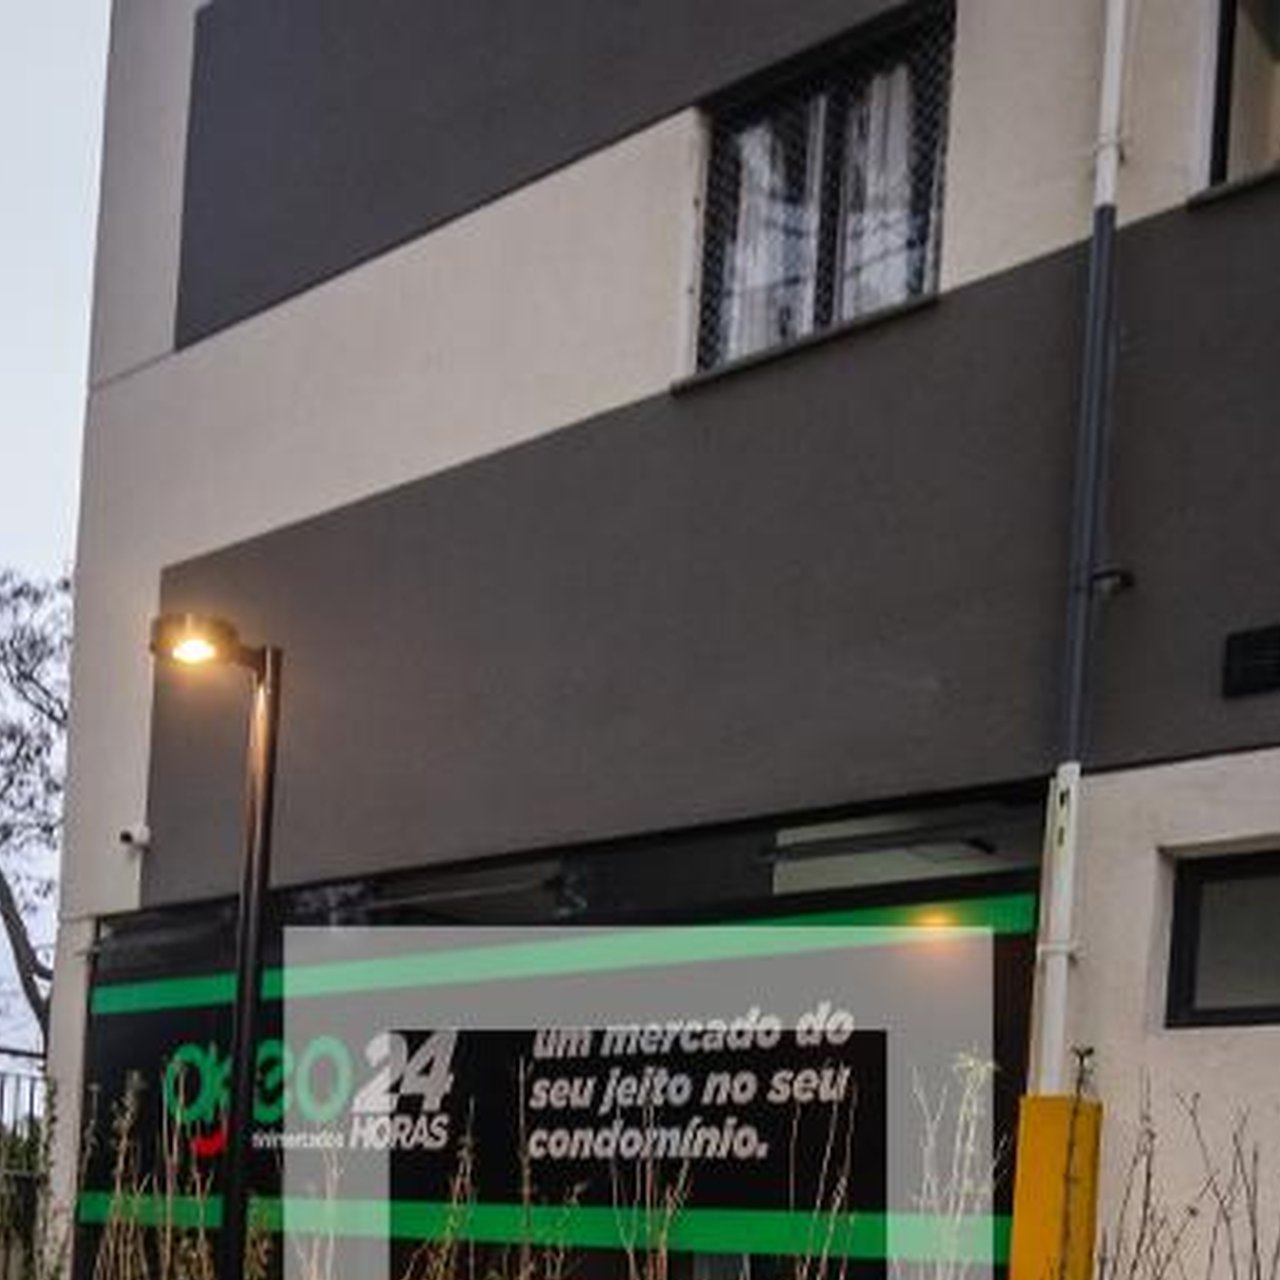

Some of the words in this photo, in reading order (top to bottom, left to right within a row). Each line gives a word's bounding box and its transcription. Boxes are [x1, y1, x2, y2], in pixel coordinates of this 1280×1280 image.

[533, 1025, 592, 1059] um
[601, 1007, 781, 1057] mercado
[796, 1000, 855, 1046] do
[351, 1029, 458, 1113] 24
[529, 1075, 597, 1110] seu
[599, 1066, 693, 1116] jeito
[702, 1070, 758, 1104] no
[767, 1066, 852, 1103] seu
[348, 1112, 450, 1151] HORAS
[529, 1116, 769, 1160] condomínio.
